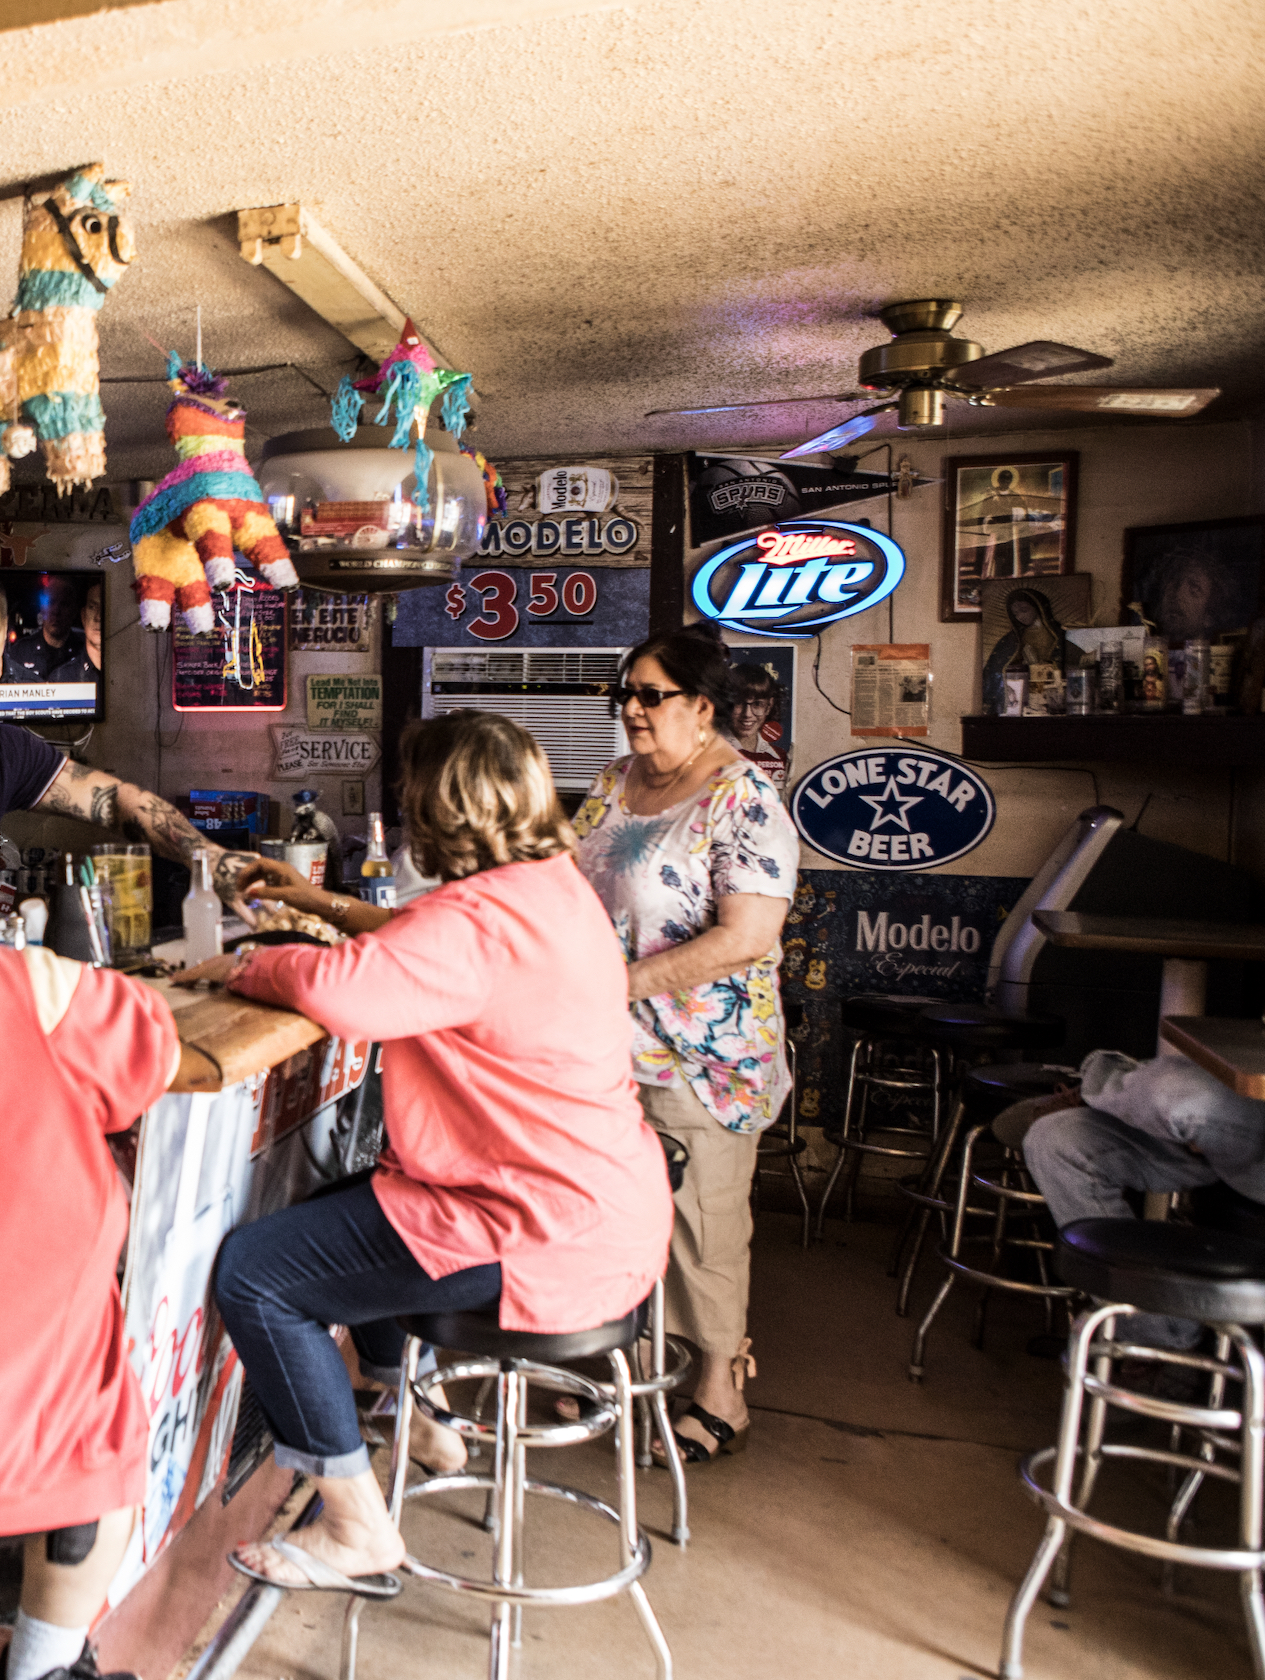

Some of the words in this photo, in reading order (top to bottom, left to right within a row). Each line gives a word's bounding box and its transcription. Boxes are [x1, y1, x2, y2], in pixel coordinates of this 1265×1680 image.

[551, 470, 567, 510] Modelo
[719, 480, 734, 489] SAN
[738, 477, 777, 485] ANTONIO
[801, 487, 822, 495] SAN
[825, 483, 869, 492] ANTONIO
[872, 481, 898, 490] SPUR
[711, 484, 786, 512] SPURS
[718, 557, 874, 619] Lite
[292, 627, 362, 643] NEGOCIO
[311, 678, 331, 686] Lead
[347, 678, 361, 686] Not
[22, 688, 56, 698] MANLEY
[310, 687, 380, 700] TEMPTATION
[317, 701, 336, 709] FOR
[345, 701, 375, 710] SHALL
[334, 710, 358, 718] FIND
[300, 739, 371, 760] SERVICE
[278, 760, 303, 772] PLEASE
[805, 757, 885, 809] LONE
[896, 758, 976, 813] STAR
[205, 817, 222, 830] 48
[847, 829, 934, 861] BEER
[856, 910, 981, 953] Modelo
[871, 952, 961, 982] Especial
